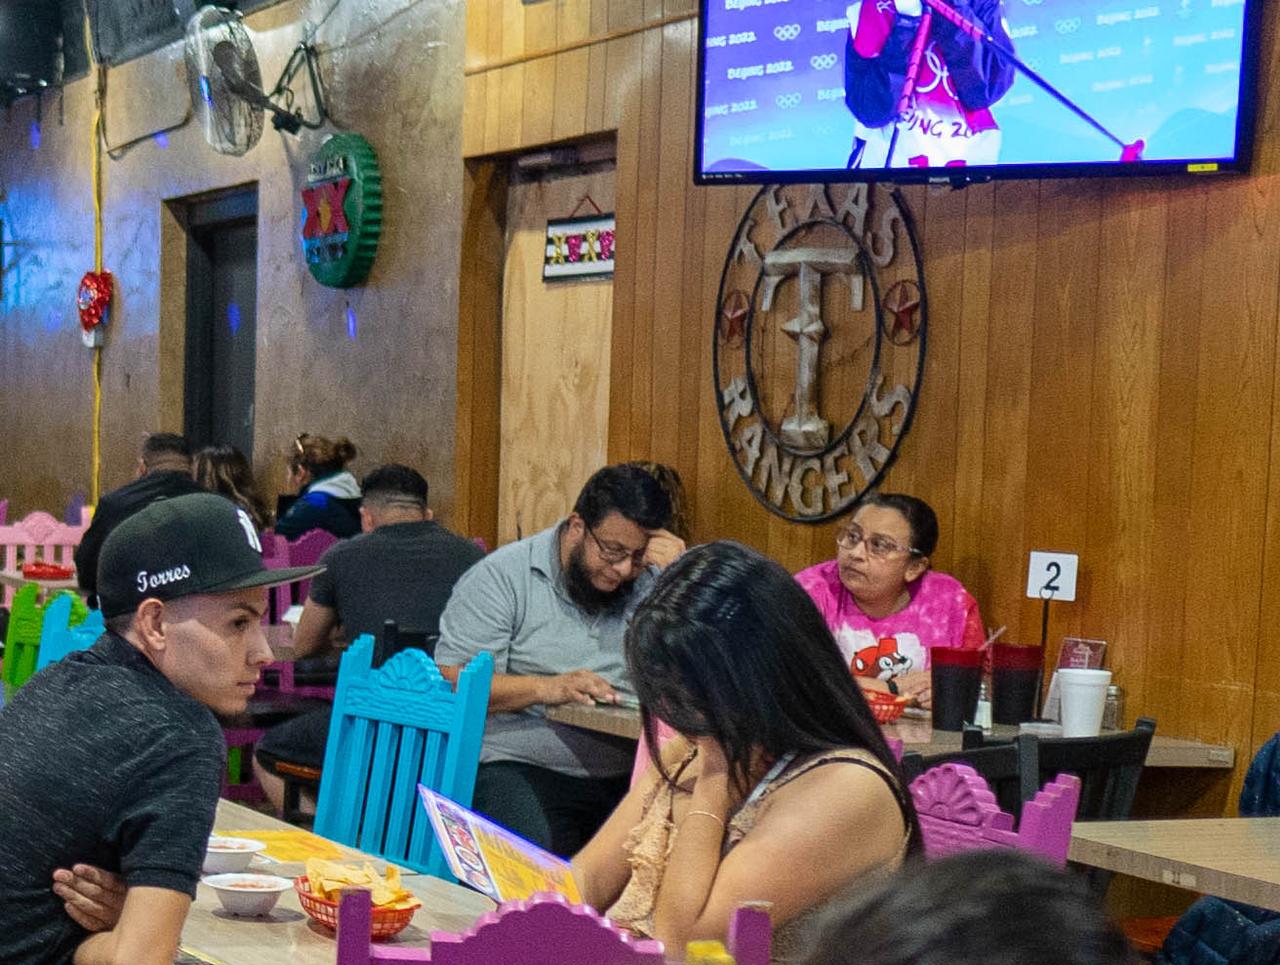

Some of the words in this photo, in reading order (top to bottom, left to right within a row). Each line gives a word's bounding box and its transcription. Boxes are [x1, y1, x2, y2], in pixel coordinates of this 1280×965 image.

[721, 372, 912, 516] RANGERS
[136, 563, 191, 593] Torres
[1043, 561, 1061, 591] 2
